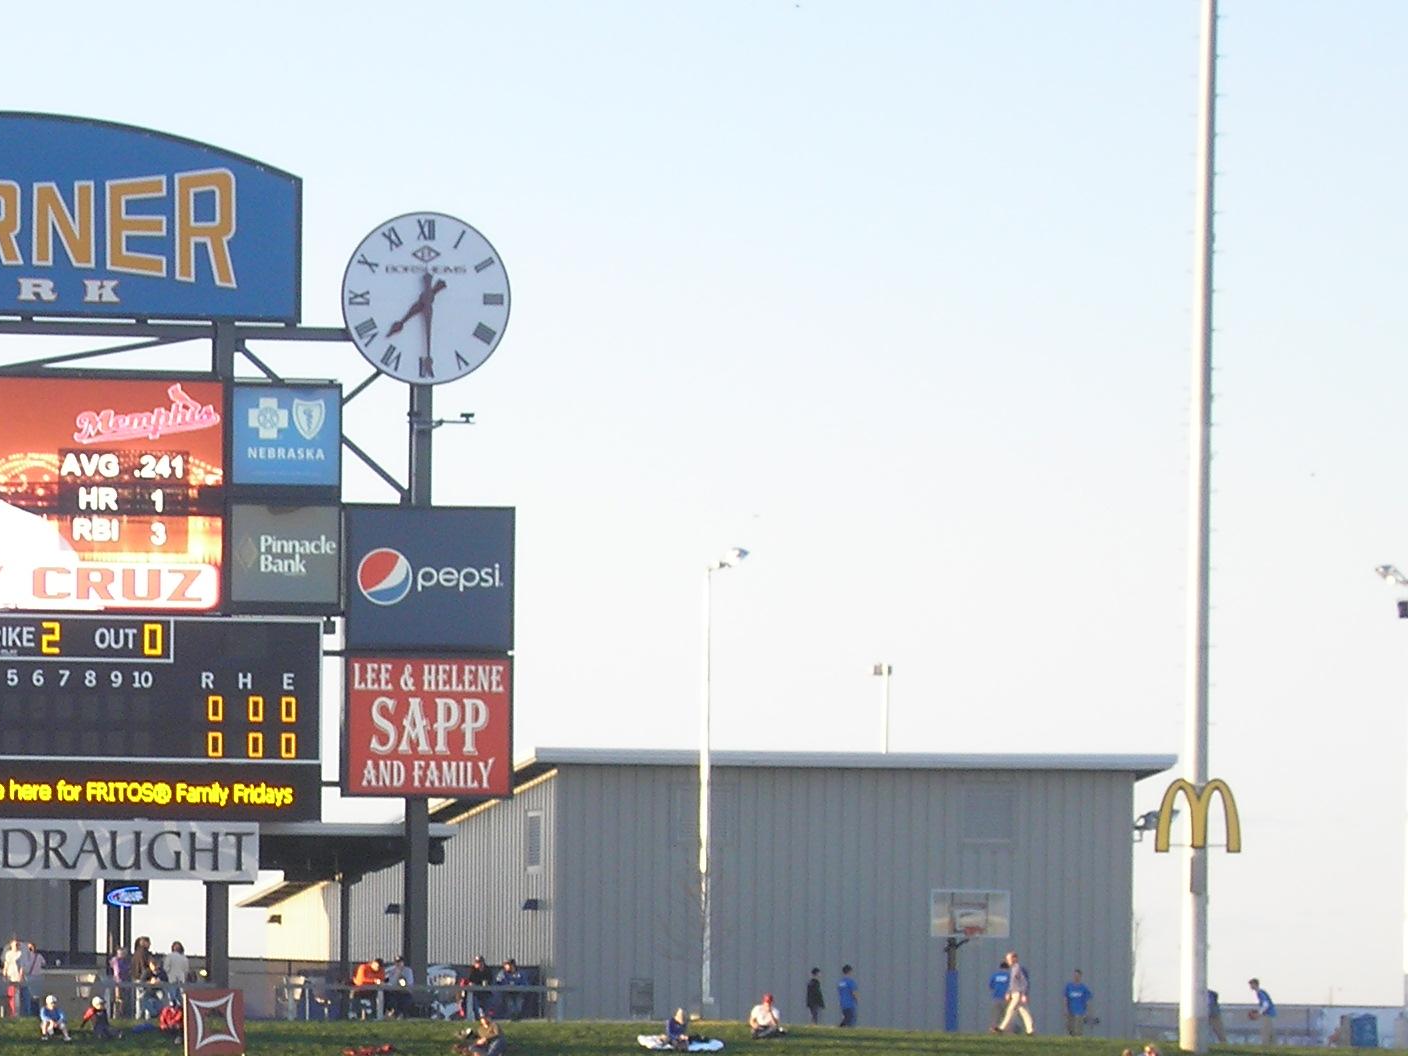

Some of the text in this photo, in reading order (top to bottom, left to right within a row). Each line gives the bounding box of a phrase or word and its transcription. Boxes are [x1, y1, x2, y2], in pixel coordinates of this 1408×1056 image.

[74, 402, 220, 444] Memphis
[60, 452, 184, 479] AVG .241
[247, 446, 326, 461] NEBRASKA
[78, 486, 164, 513] HR 1
[72, 517, 167, 546] RBI 3
[260, 534, 337, 554] Pinnacle
[260, 554, 307, 574] Bank
[417, 563, 500, 592] pepsi
[32, 566, 203, 602] CRUZ
[41, 622, 61, 654] 2
[94, 628, 137, 650] OUT
[143, 623, 163, 656] 0
[7, 669, 18, 686] 5
[32, 669, 44, 686] 6
[59, 670, 70, 687] 7
[84, 670, 96, 687] 8
[111, 671, 122, 688] 9
[132, 671, 153, 688] 10
[201, 672, 214, 689] R
[238, 672, 252, 690] H
[283, 673, 295, 690] E
[353, 663, 504, 692] LEE & HELENE
[208, 695, 223, 722] 0
[248, 696, 264, 722] 0
[281, 696, 296, 723] 0
[370, 696, 490, 756] SAPP
[208, 732, 223, 757] 0
[248, 732, 263, 758] 0
[281, 732, 296, 758] 0
[361, 757, 496, 789] AND FAMILY
[9, 779, 51, 801] here
[57, 780, 82, 801] for
[86, 781, 171, 804] FRITOS®
[176, 782, 229, 806] Family
[233, 783, 293, 807] Fridays
